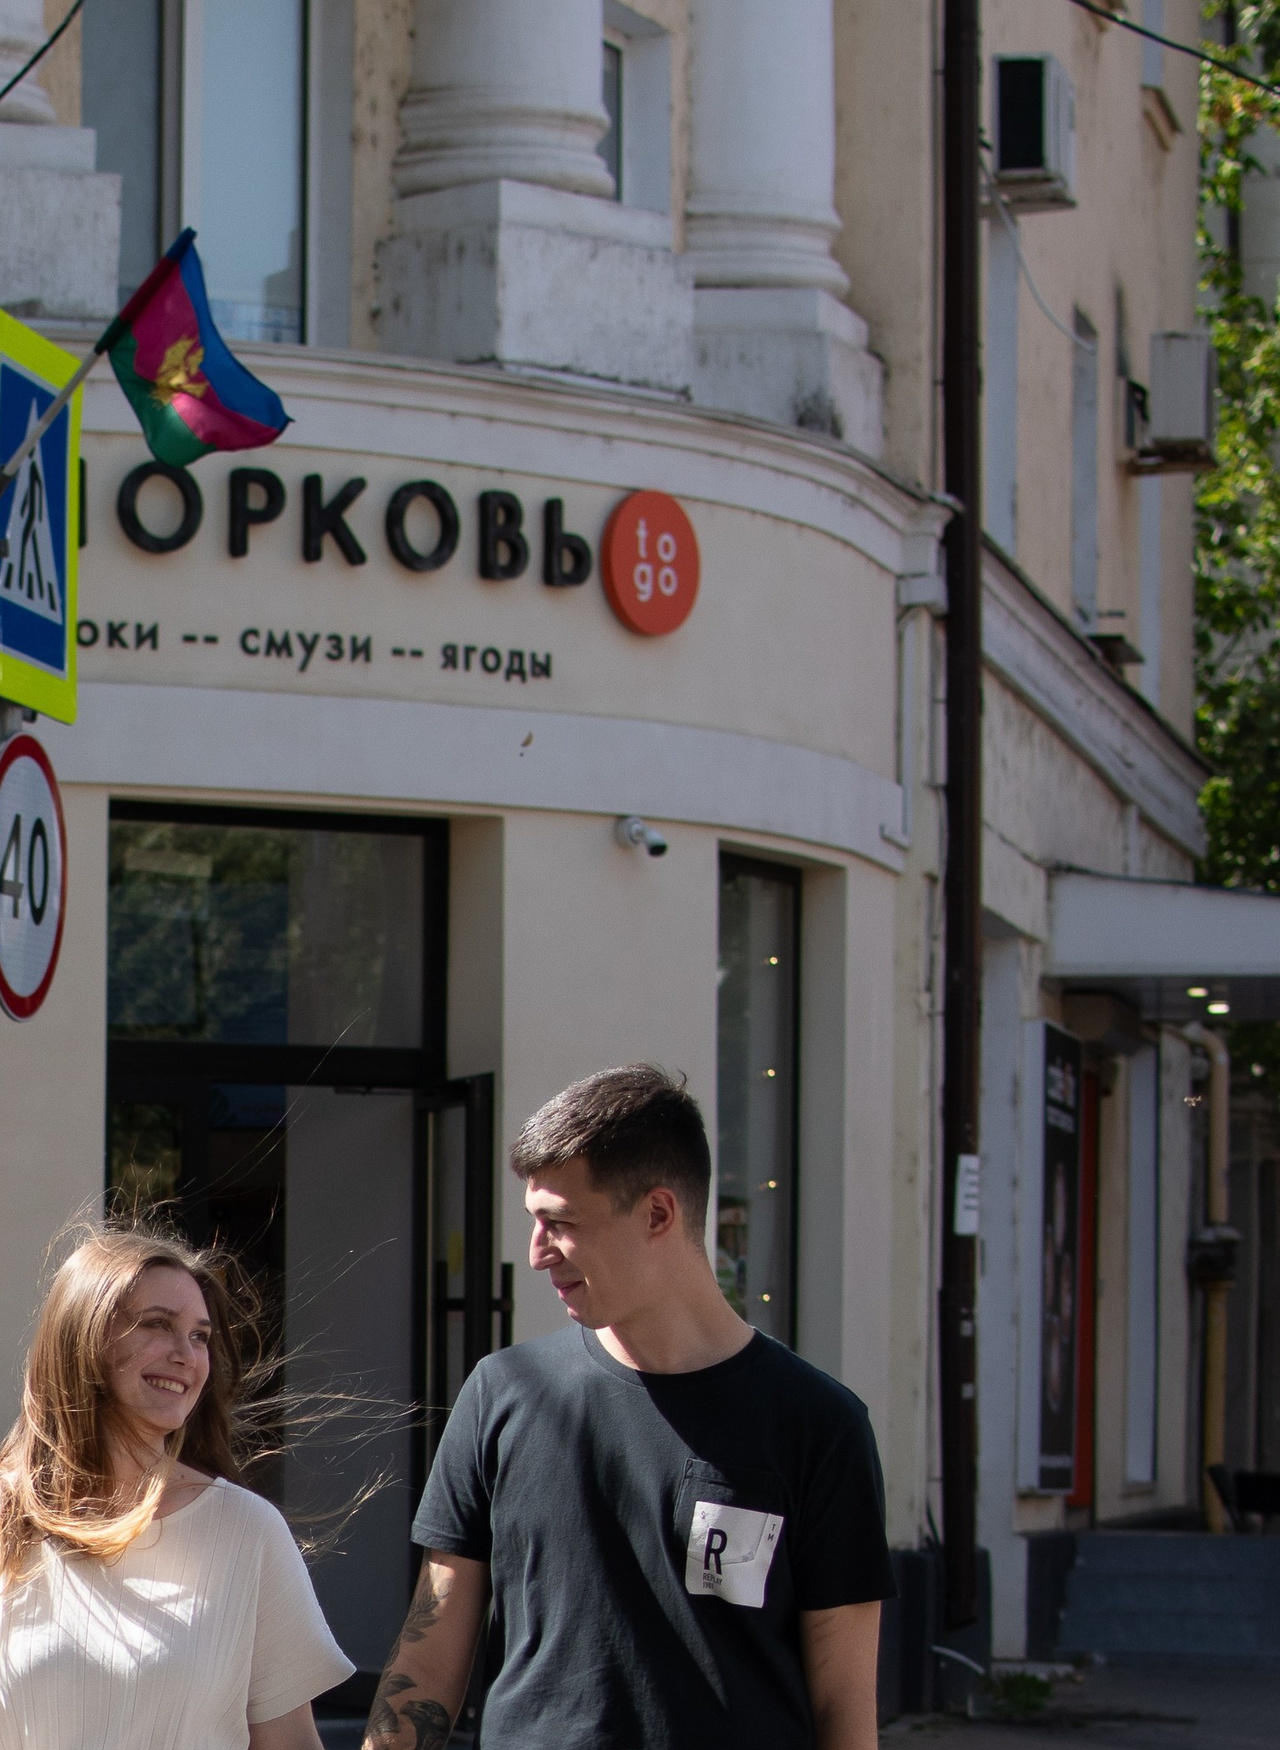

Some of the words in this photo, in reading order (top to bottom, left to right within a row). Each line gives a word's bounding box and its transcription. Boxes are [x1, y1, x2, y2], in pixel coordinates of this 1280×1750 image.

[79, 456, 593, 587] ОРКОВЬ
[636, 517, 677, 563] to
[633, 563, 679, 603] go
[77, 618, 160, 651] оки
[238, 627, 374, 674] смузи
[440, 642, 553, 683] ягоды
[703, 1526, 728, 1576] R
[701, 1571, 723, 1587] REPLAY
